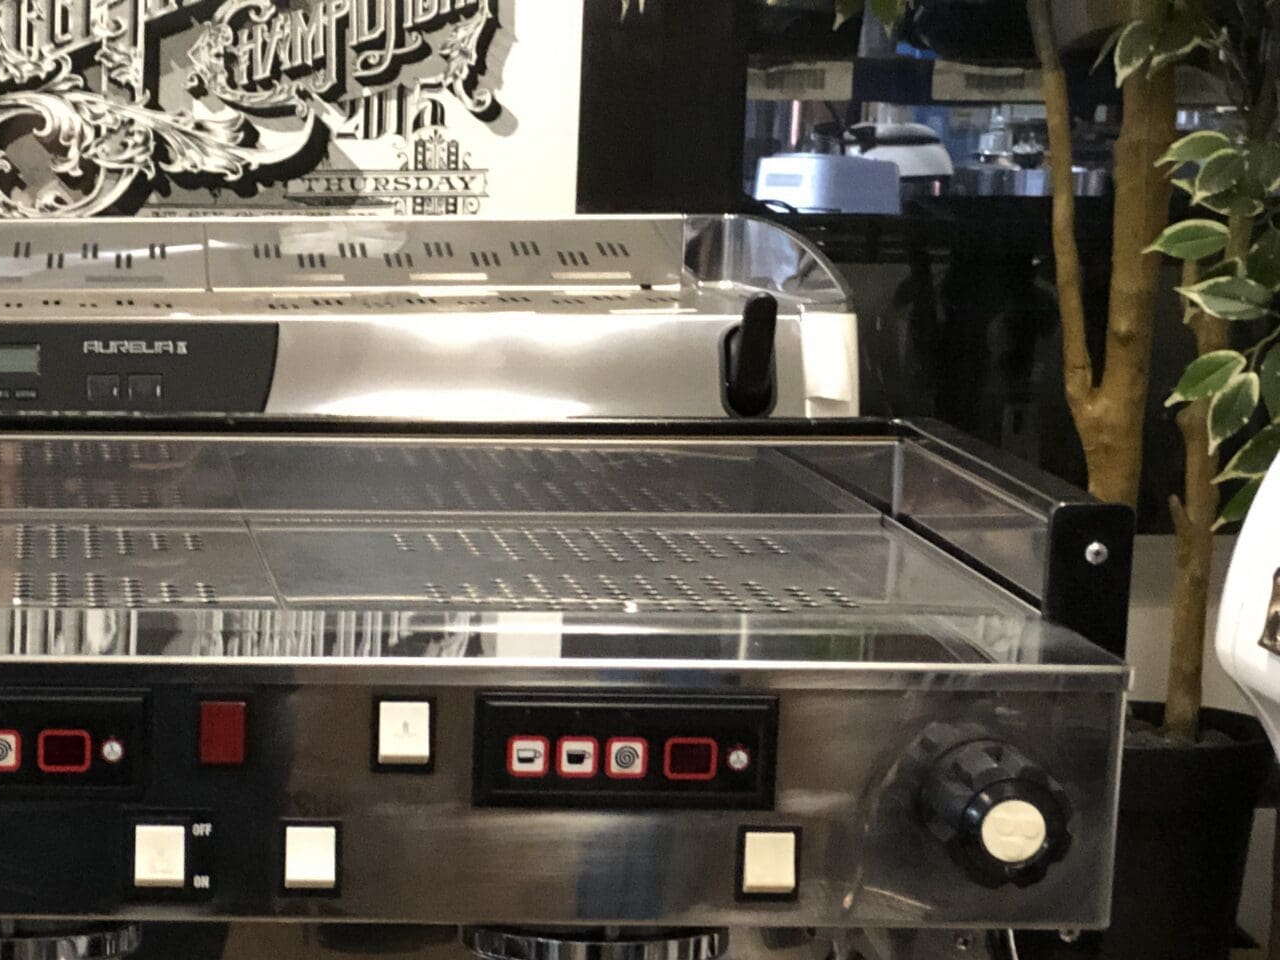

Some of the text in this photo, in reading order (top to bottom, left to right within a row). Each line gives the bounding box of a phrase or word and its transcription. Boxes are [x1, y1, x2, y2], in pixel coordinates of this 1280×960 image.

[304, 176, 476, 192] THURSDAY
[83, 340, 174, 354] AURELIA
[192, 823, 212, 837] OFF
[193, 875, 209, 889] ON
